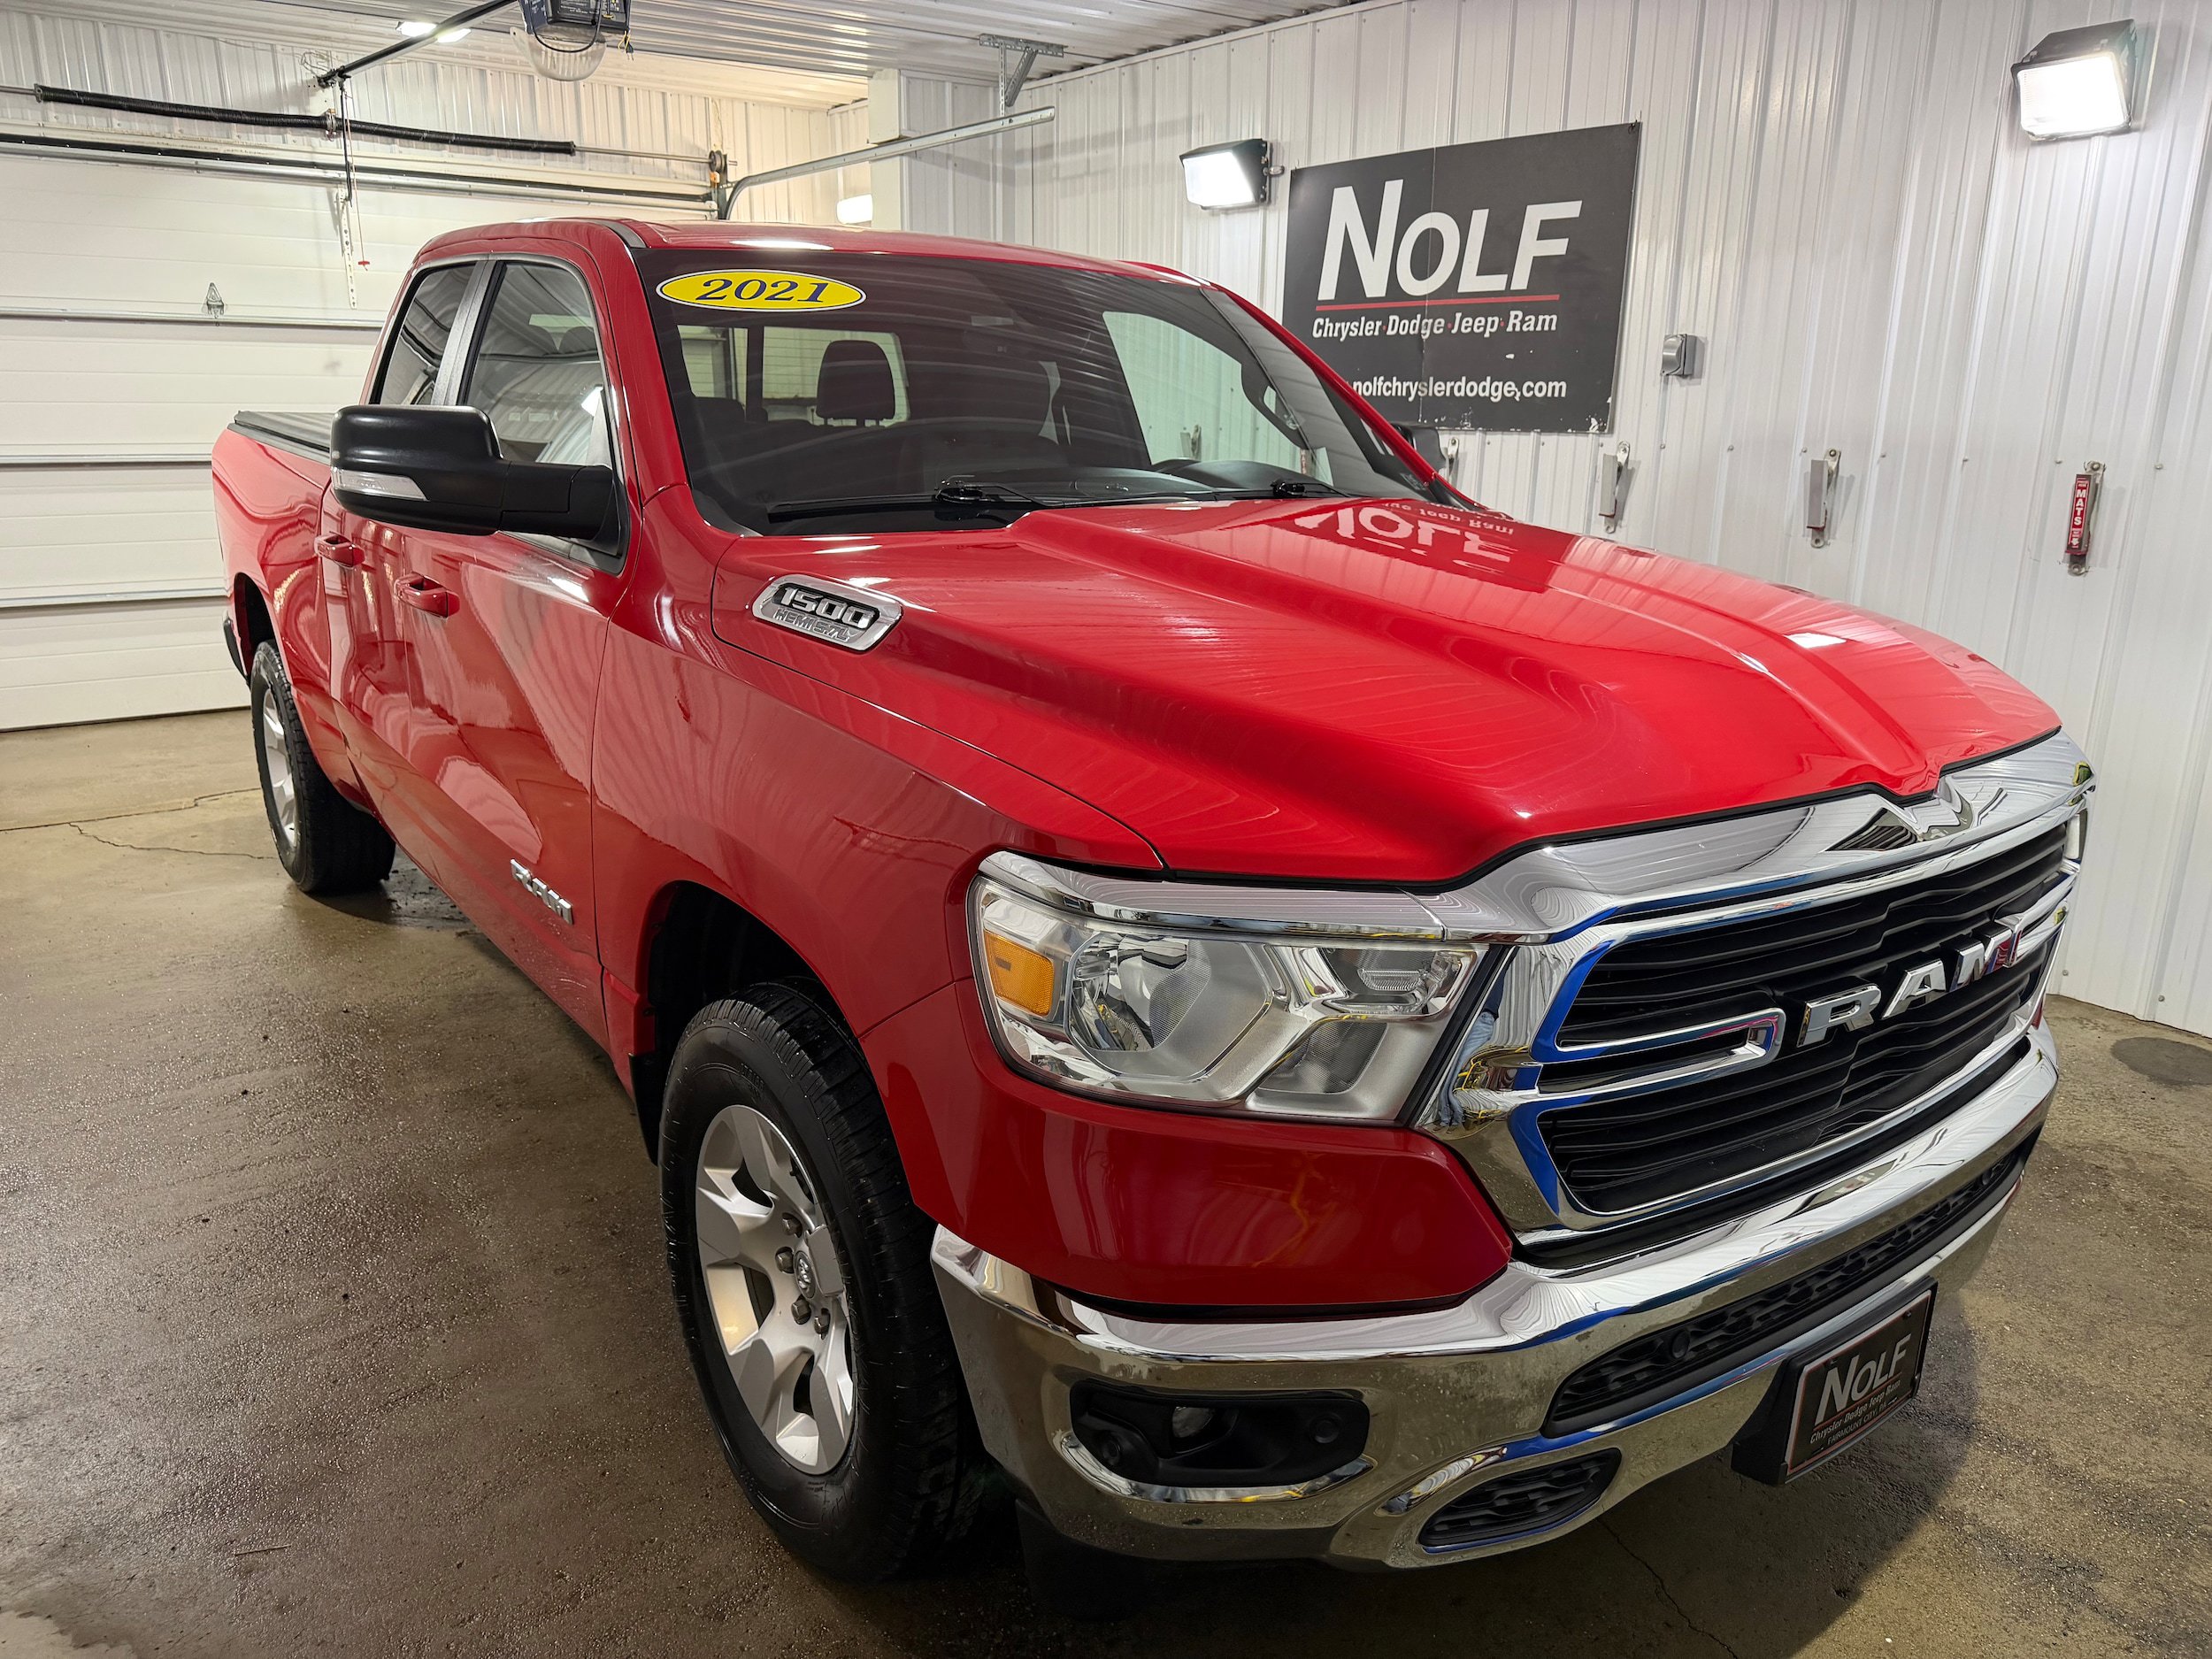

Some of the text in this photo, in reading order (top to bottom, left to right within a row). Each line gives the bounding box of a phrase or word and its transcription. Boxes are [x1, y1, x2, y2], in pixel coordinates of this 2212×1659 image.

[1317, 179, 1582, 301] NOLF
[695, 279, 828, 303] 2021
[1312, 310, 1558, 342] Chrysler Dodge Jeep Ram
[2073, 489, 2086, 526] MATS
[780, 587, 876, 629] 1500
[511, 858, 573, 926] RAM
[1796, 928, 2017, 1048] RAM
[1814, 1333, 1912, 1426] NOLF
[1809, 1419, 1842, 1444] Chrysler
[1844, 1403, 1868, 1424] Dodge
[1869, 1391, 1885, 1409] Jeep
[1827, 1418, 1863, 1445] FAIRMOUNT
